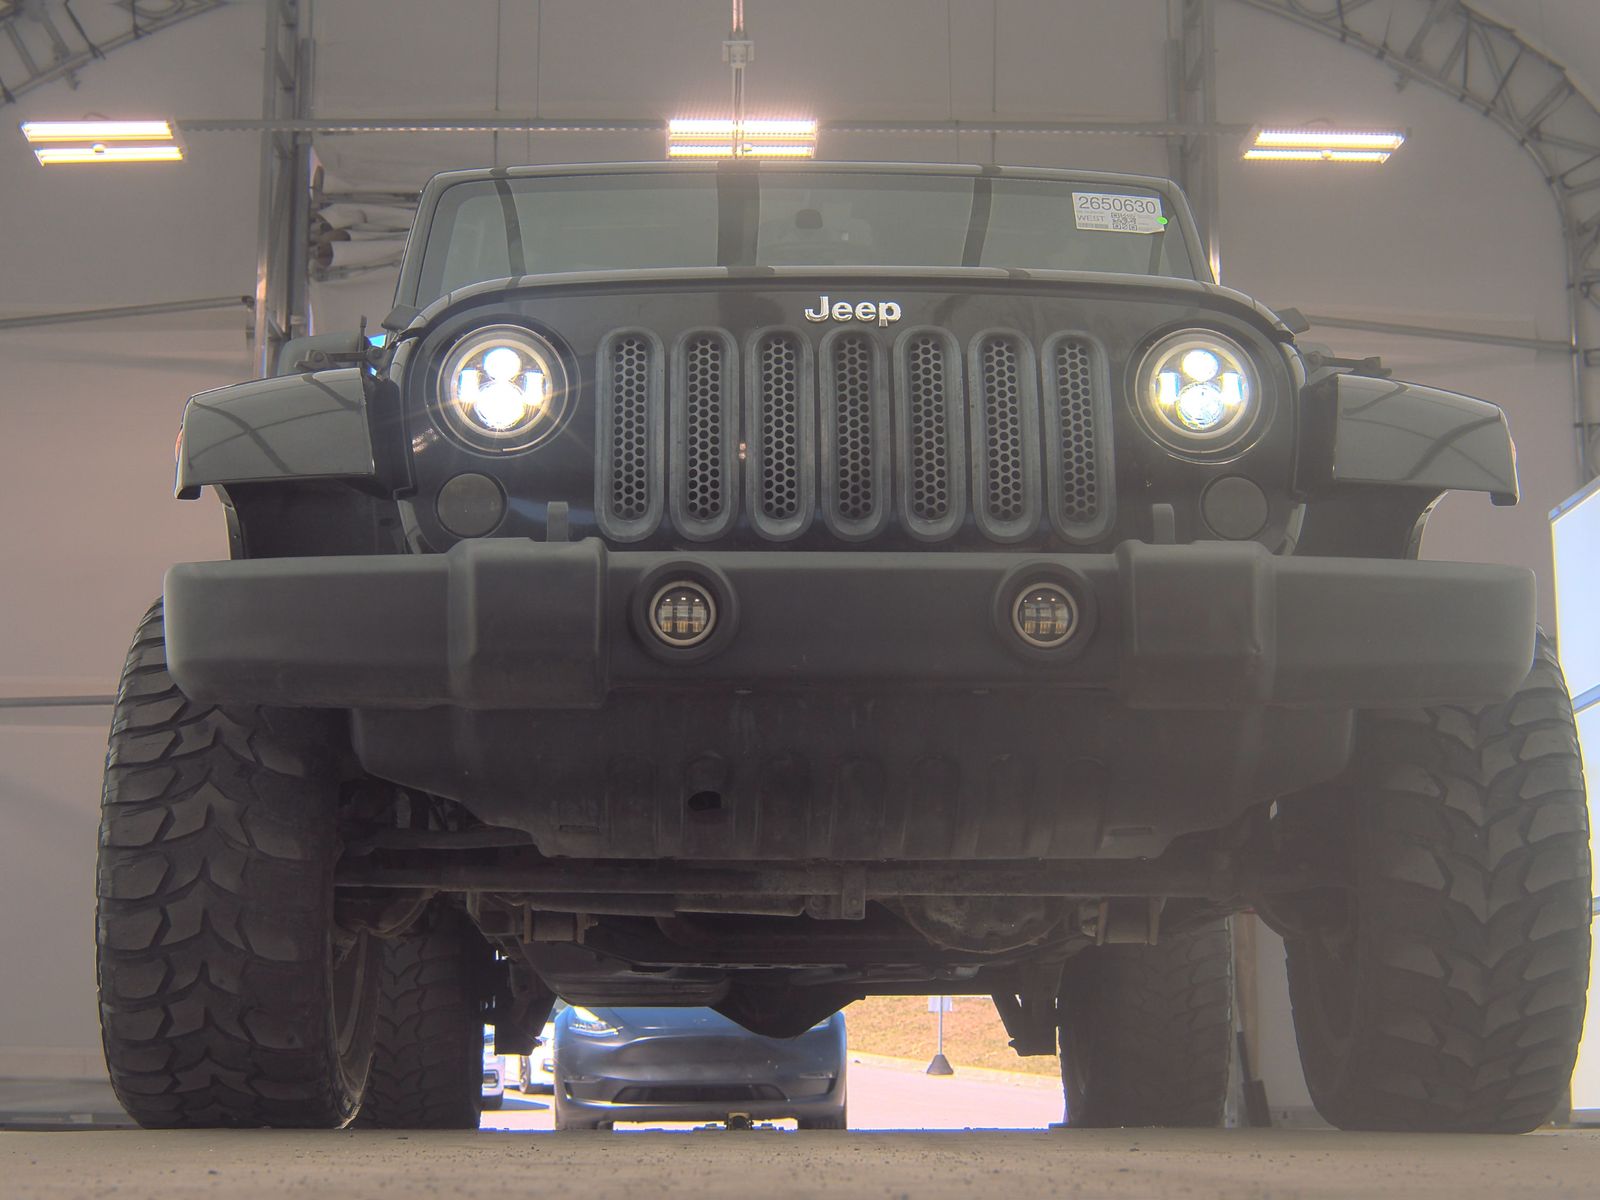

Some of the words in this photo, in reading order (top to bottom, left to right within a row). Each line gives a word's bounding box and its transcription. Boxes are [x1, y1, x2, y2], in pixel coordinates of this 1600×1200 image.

[1078, 196, 1156, 214] 2650630
[1077, 214, 1105, 222] WEST
[804, 296, 902, 327] Jeep
